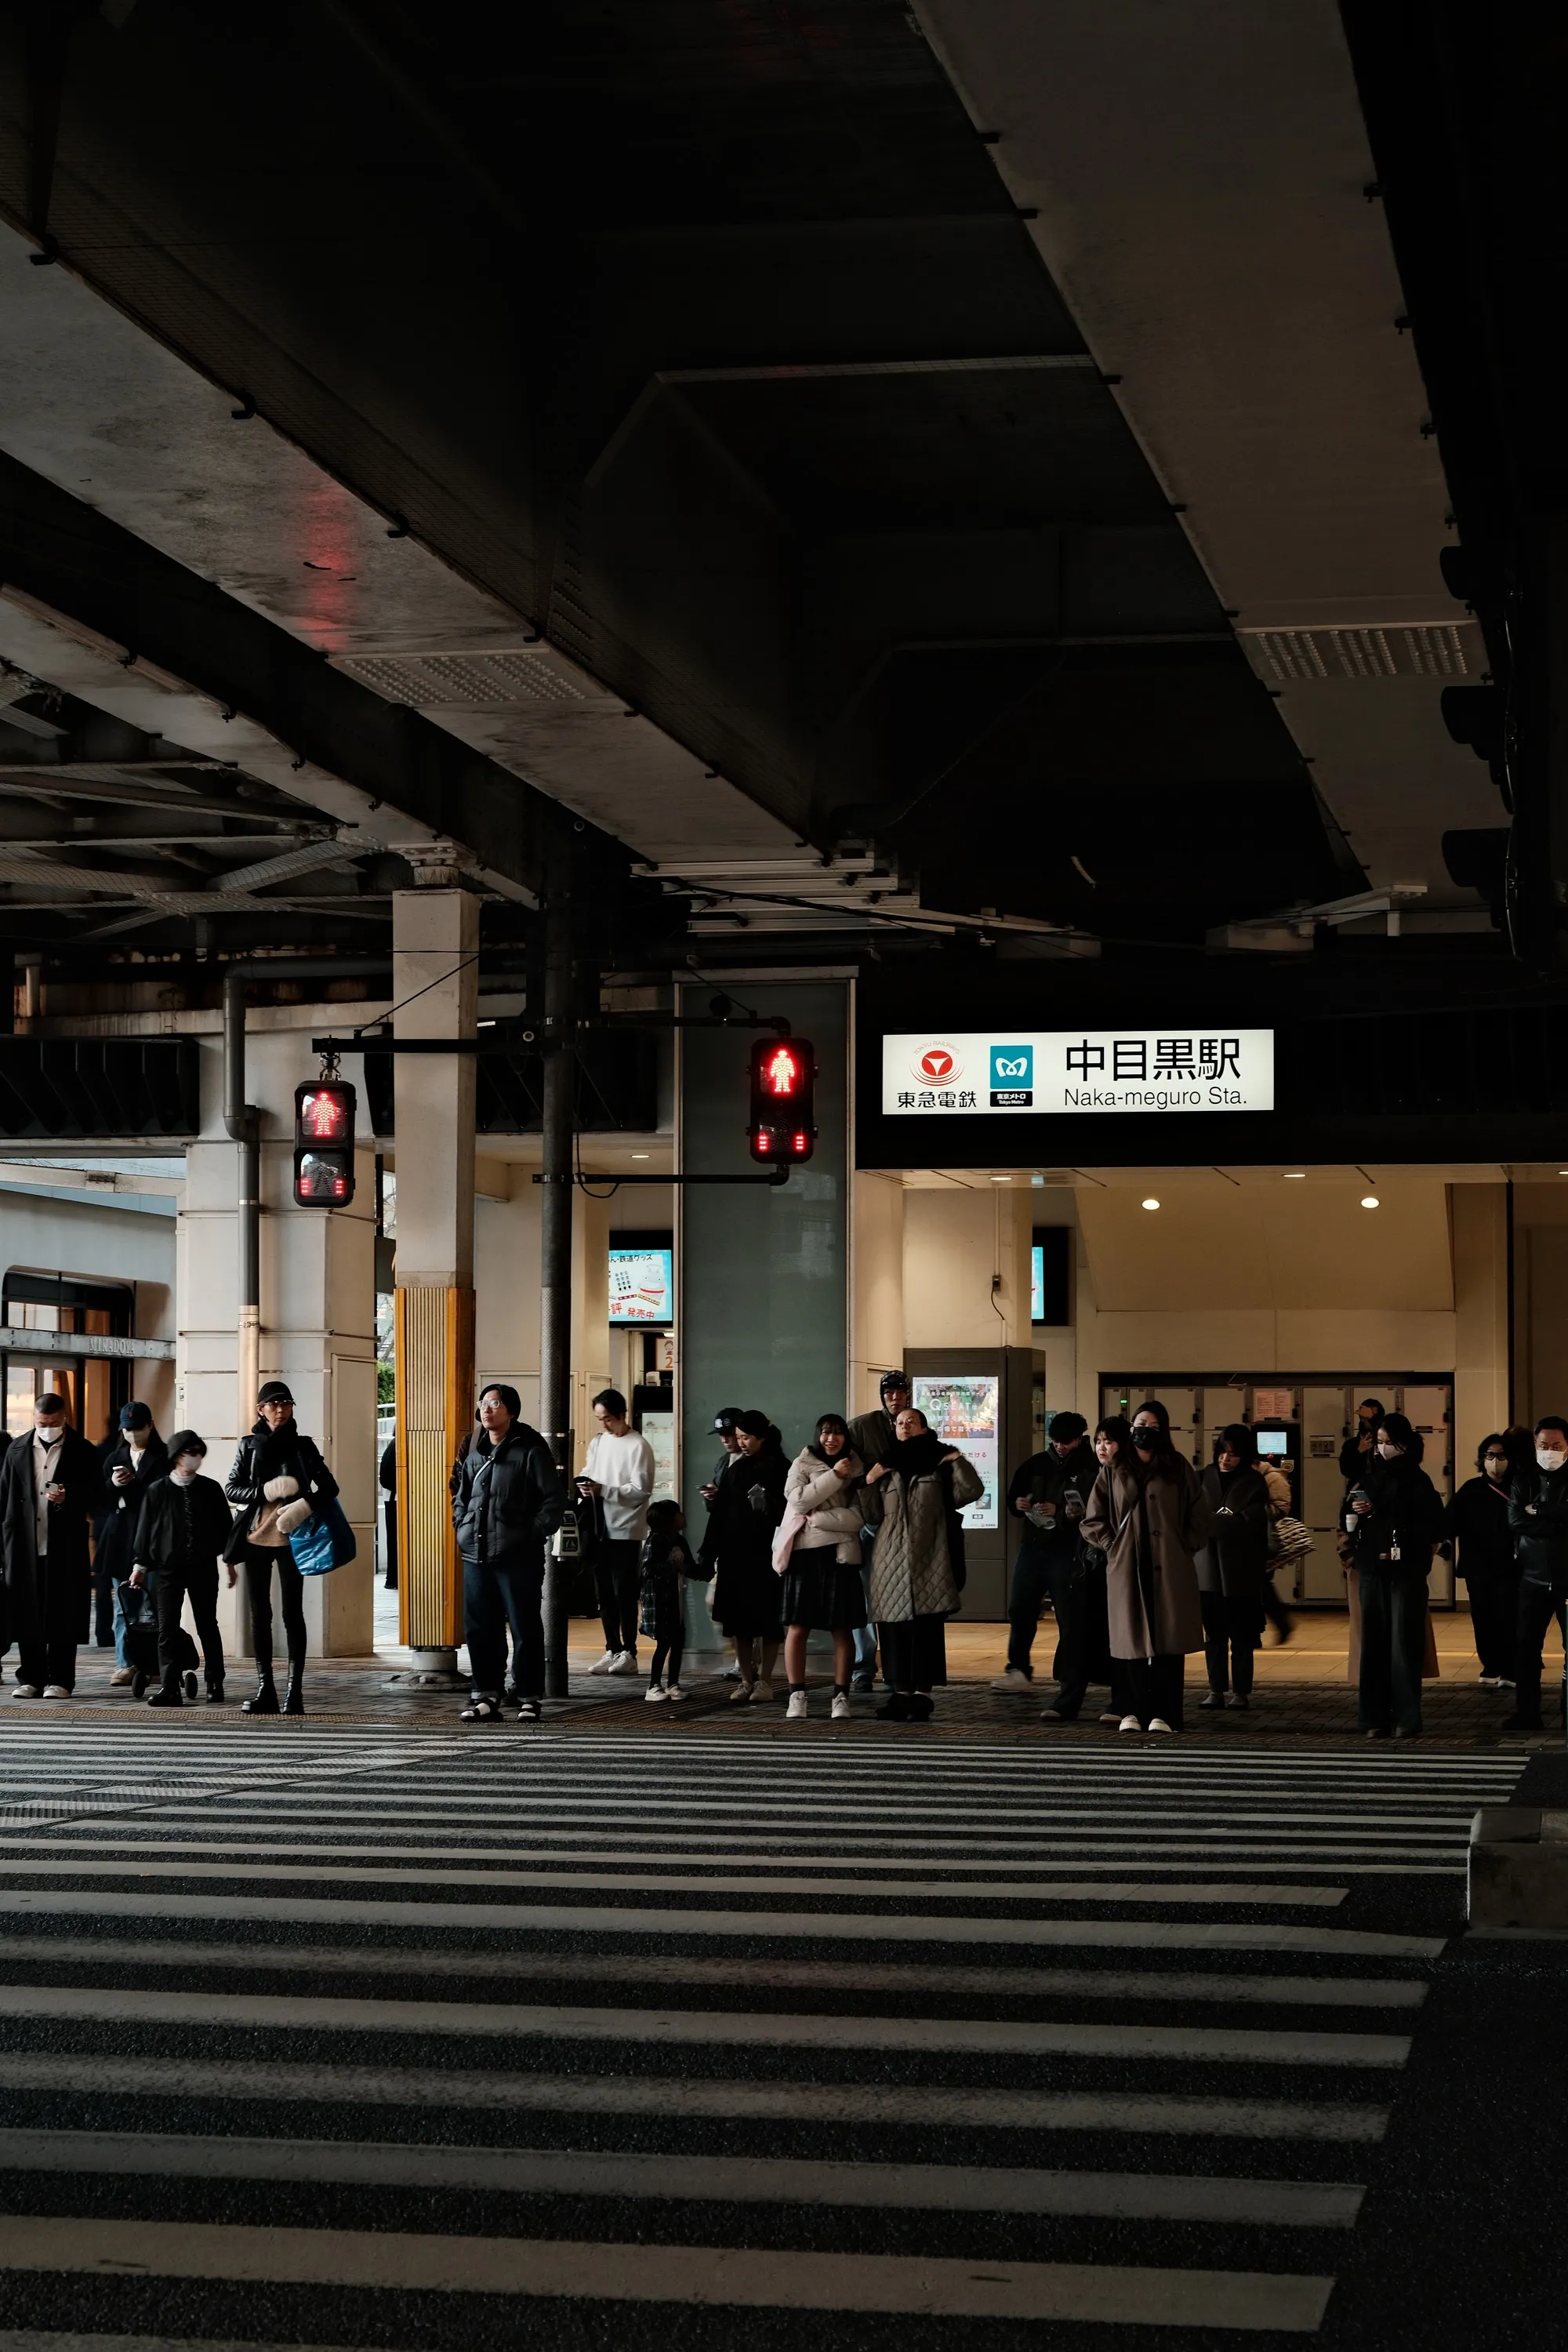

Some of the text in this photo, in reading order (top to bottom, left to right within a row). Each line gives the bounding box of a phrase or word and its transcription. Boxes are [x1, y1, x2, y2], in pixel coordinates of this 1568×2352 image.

[913, 1041, 932, 1055] TOKYU
[1066, 1039, 1241, 1082] 中目黒駅
[897, 1091, 977, 1109] 東急電鉄
[1065, 1086, 1247, 1110] Naka-meguro Sta.
[609, 1254, 653, 1263] ん・鉄道グッズ
[627, 1307, 655, 1320] 発売中
[89, 1338, 136, 1355] MIKADOYA
